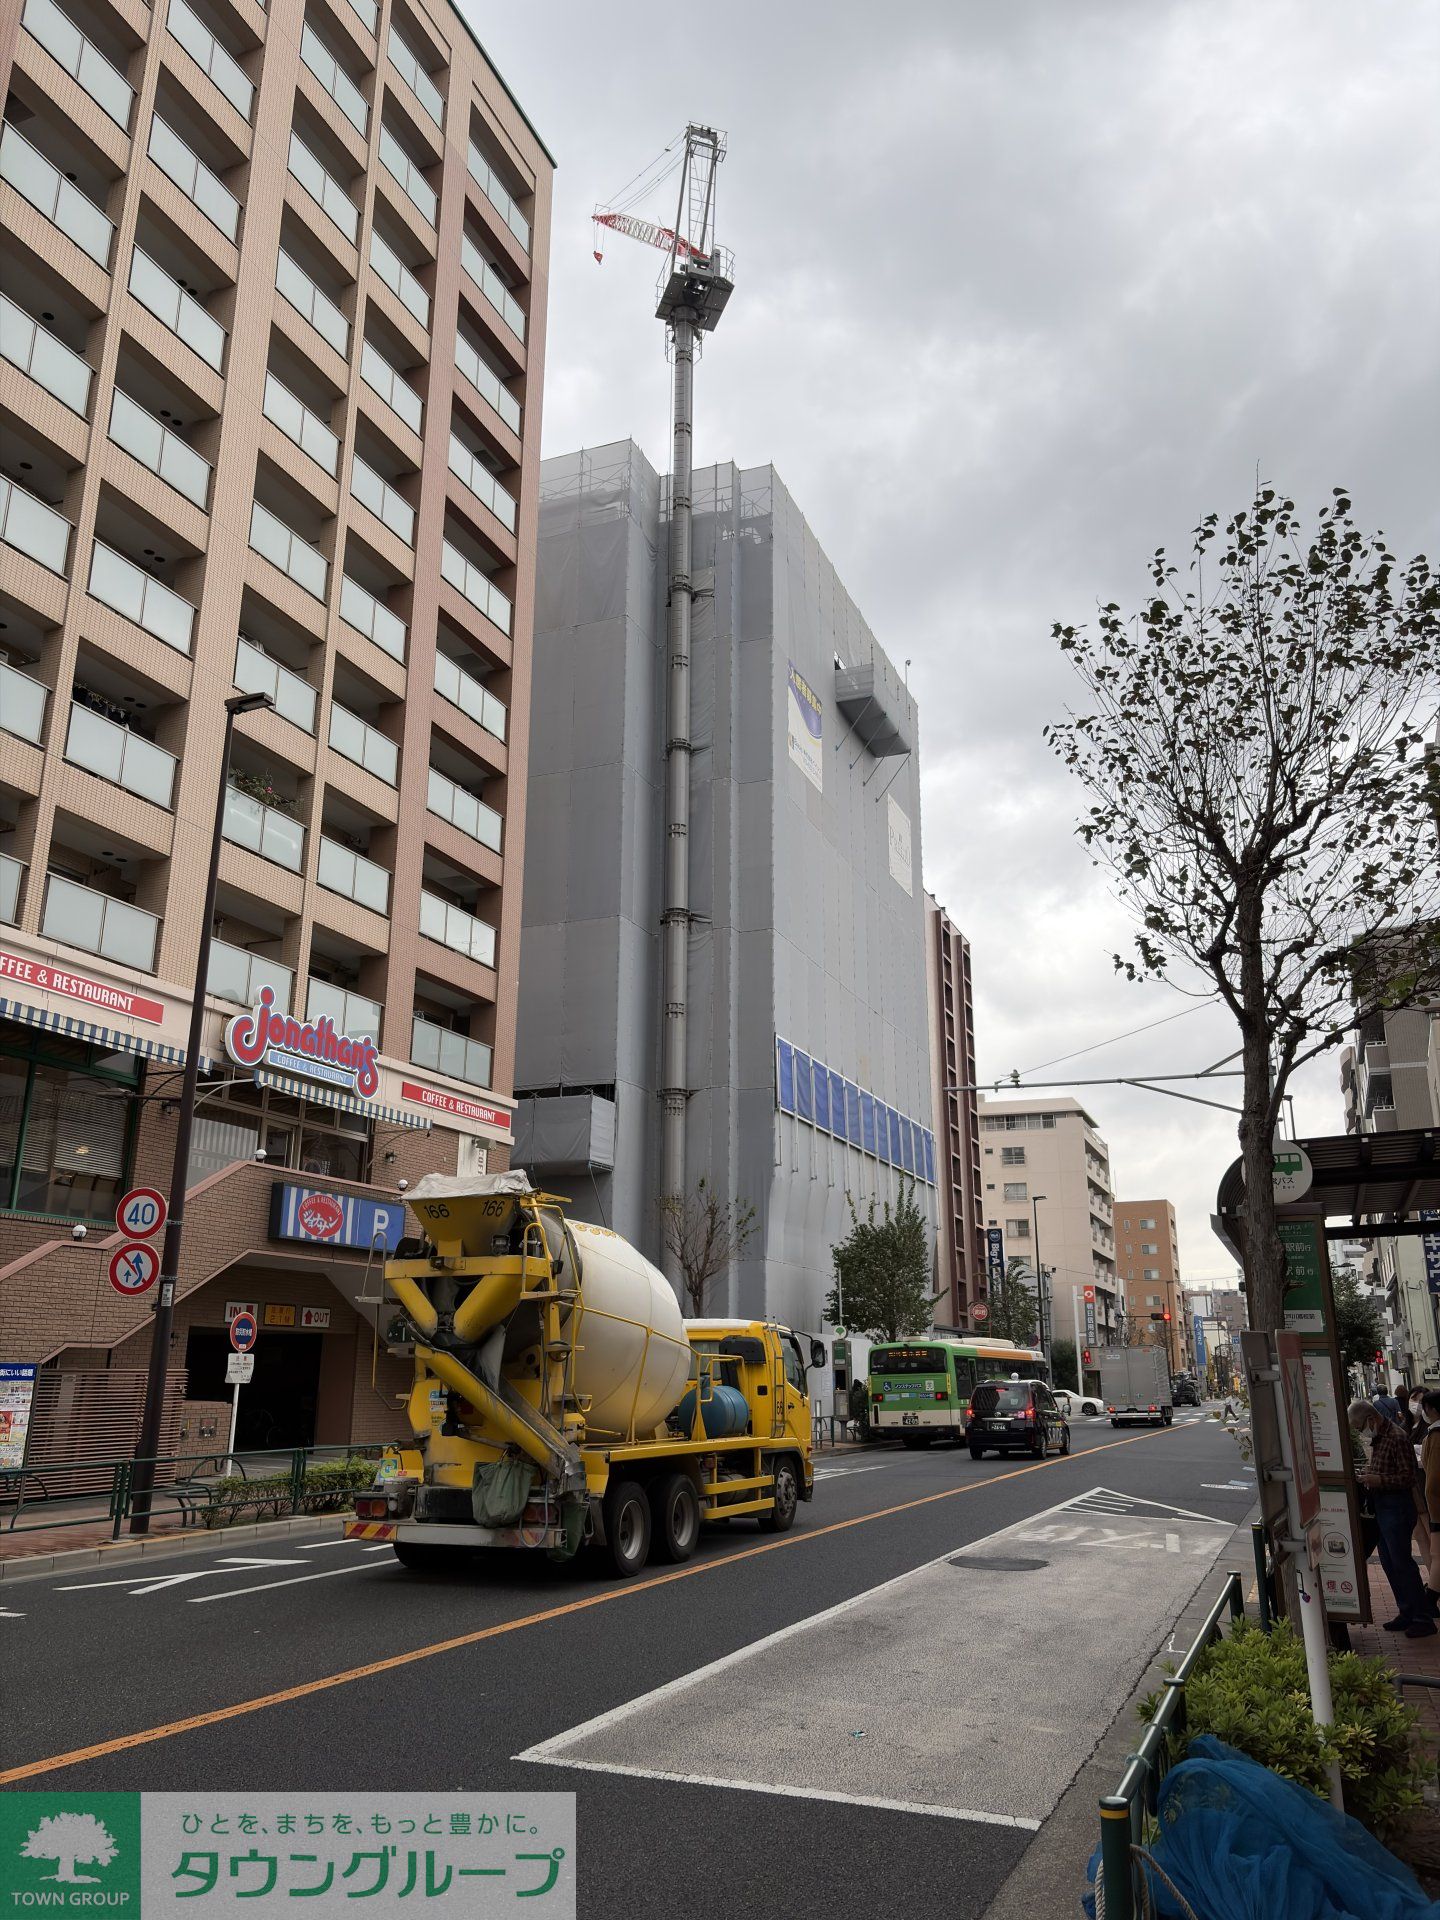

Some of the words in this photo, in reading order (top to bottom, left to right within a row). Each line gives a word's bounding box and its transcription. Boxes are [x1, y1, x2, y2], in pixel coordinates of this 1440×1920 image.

[37, 969, 47, 985] &
[53, 973, 134, 1011] RESTAURANT
[277, 1055, 301, 1070] COFFEE
[302, 1063, 308, 1072] &
[309, 1064, 348, 1085] RESTAURANT
[422, 1090, 446, 1108] COFFEE
[449, 1099, 455, 1110] &
[456, 1101, 496, 1123] RESTAURANT
[126, 1203, 155, 1227] 40
[424, 1203, 450, 1220] 166
[482, 1199, 506, 1217] 166
[303, 1209, 339, 1236] ジョナサン
[372, 1208, 390, 1242] P
[229, 1306, 242, 1318] IN
[314, 1312, 329, 1324] OUT
